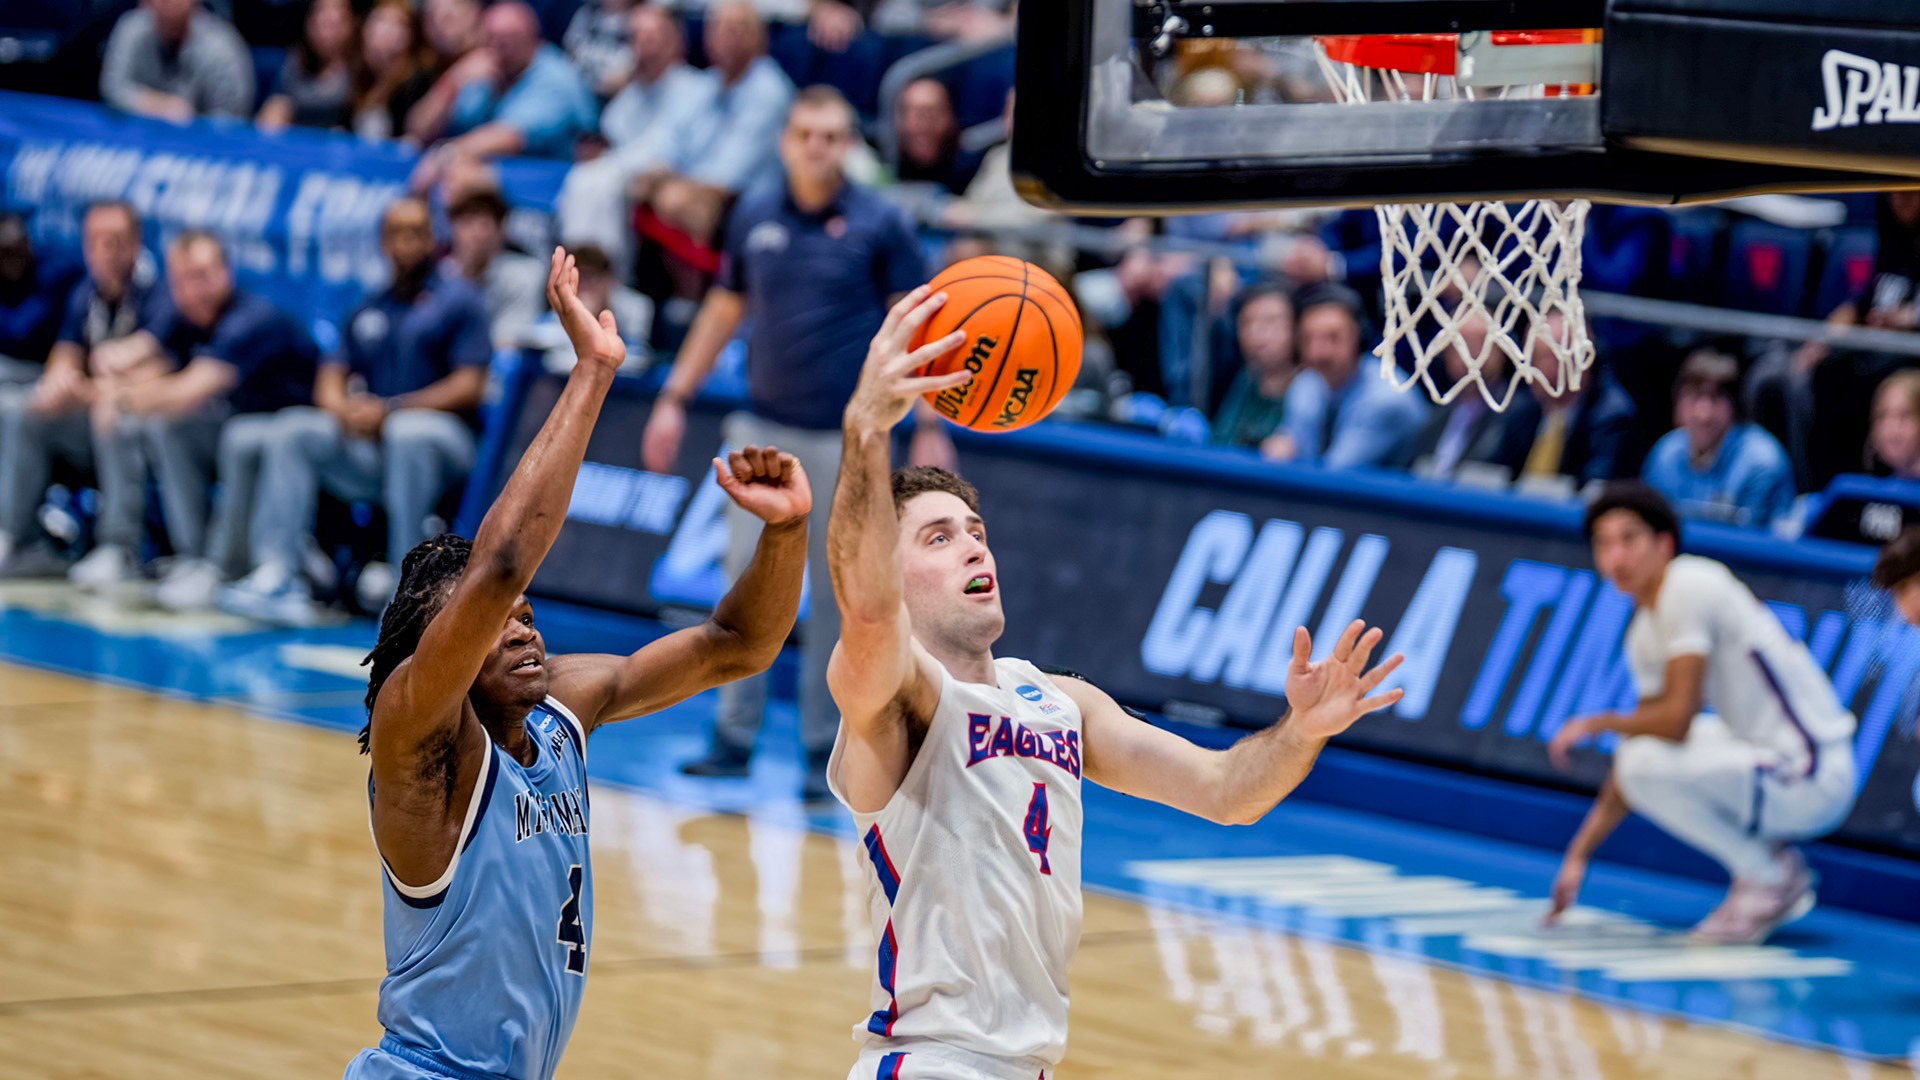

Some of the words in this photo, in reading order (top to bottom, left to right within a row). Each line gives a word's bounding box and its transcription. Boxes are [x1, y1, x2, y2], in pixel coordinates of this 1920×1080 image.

[934, 335, 997, 420] Wilon
[991, 368, 1039, 427] NCAA
[1363, 545, 1478, 722] A
[965, 711, 1081, 781] EAGLES
[1022, 781, 1053, 876] 4
[556, 863, 587, 977] 4
